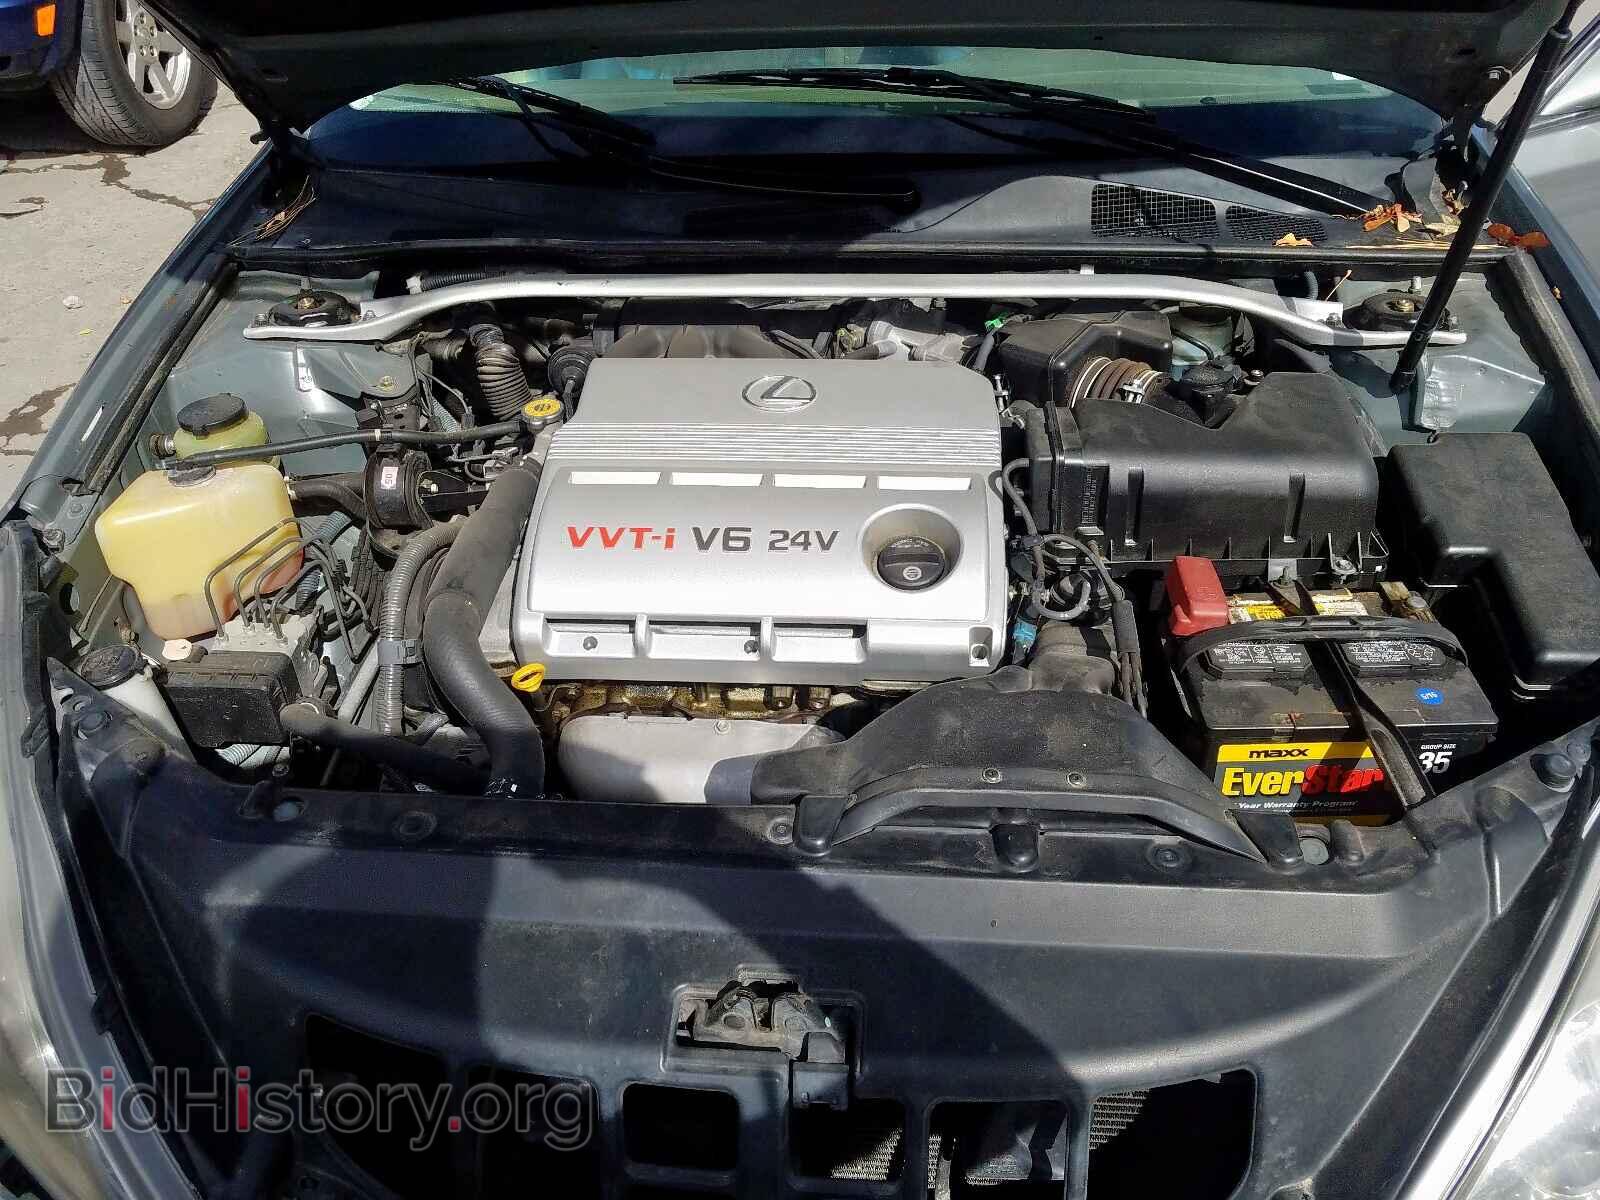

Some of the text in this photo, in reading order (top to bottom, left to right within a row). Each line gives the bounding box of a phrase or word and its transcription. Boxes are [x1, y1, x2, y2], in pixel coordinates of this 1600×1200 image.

[567, 526, 840, 552] VVT-i V6 24V
[1249, 748, 1309, 759] maxx
[1419, 751, 1452, 774] 35
[1221, 764, 1392, 797] EverStar
